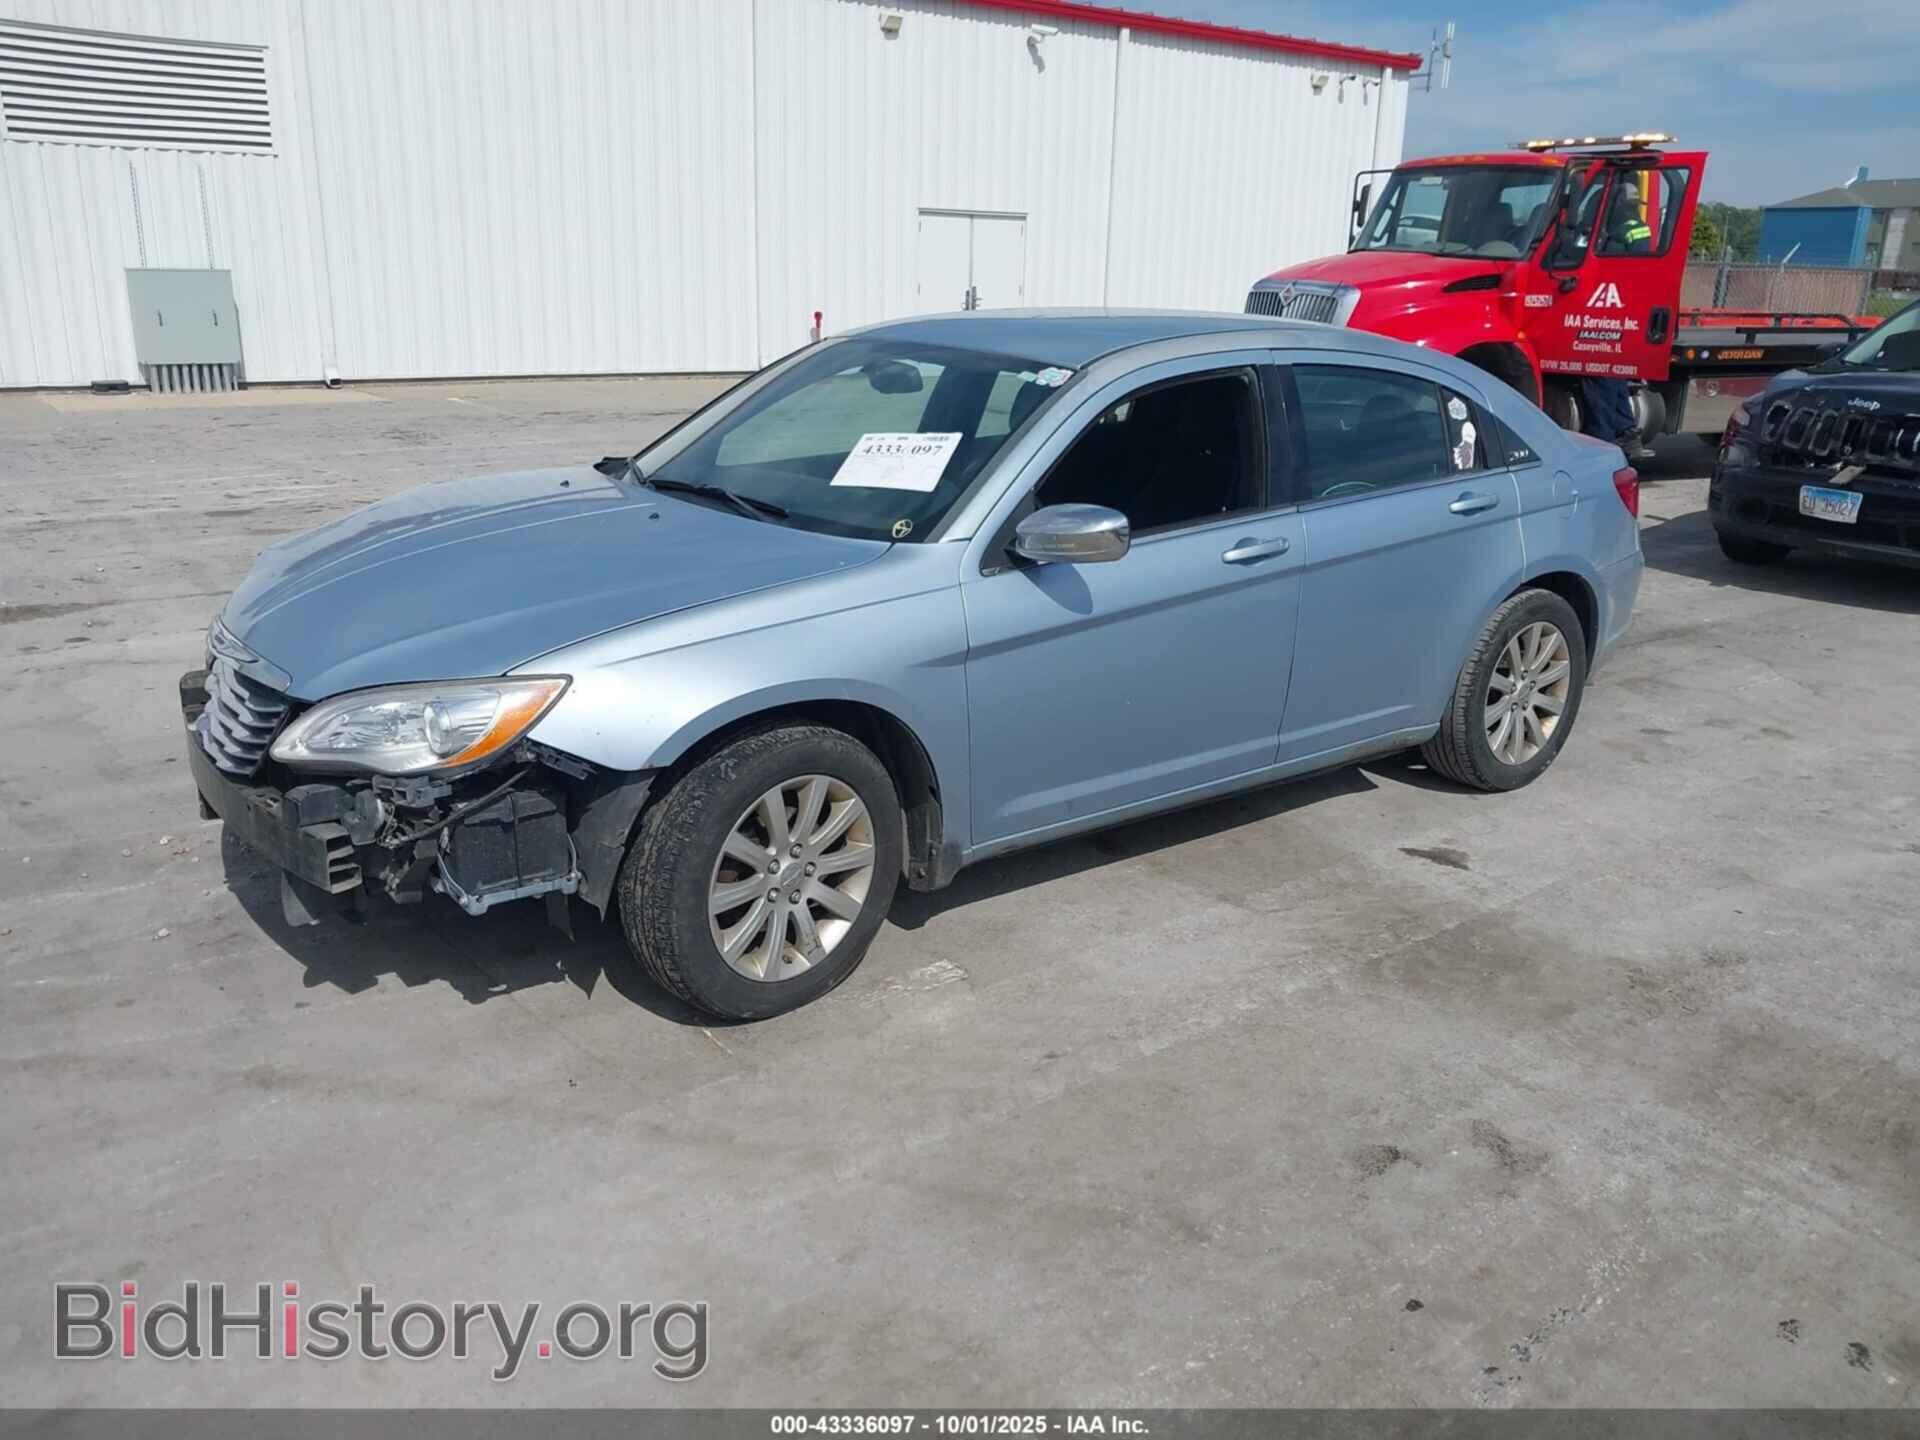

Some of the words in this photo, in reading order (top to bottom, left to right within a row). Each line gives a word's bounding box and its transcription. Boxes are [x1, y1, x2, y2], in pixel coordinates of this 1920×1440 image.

[1564, 314, 1581, 327] IAA
[1624, 317, 1639, 330] Inc.
[1615, 343, 1622, 353] IL
[1848, 398, 1880, 411] Jeep
